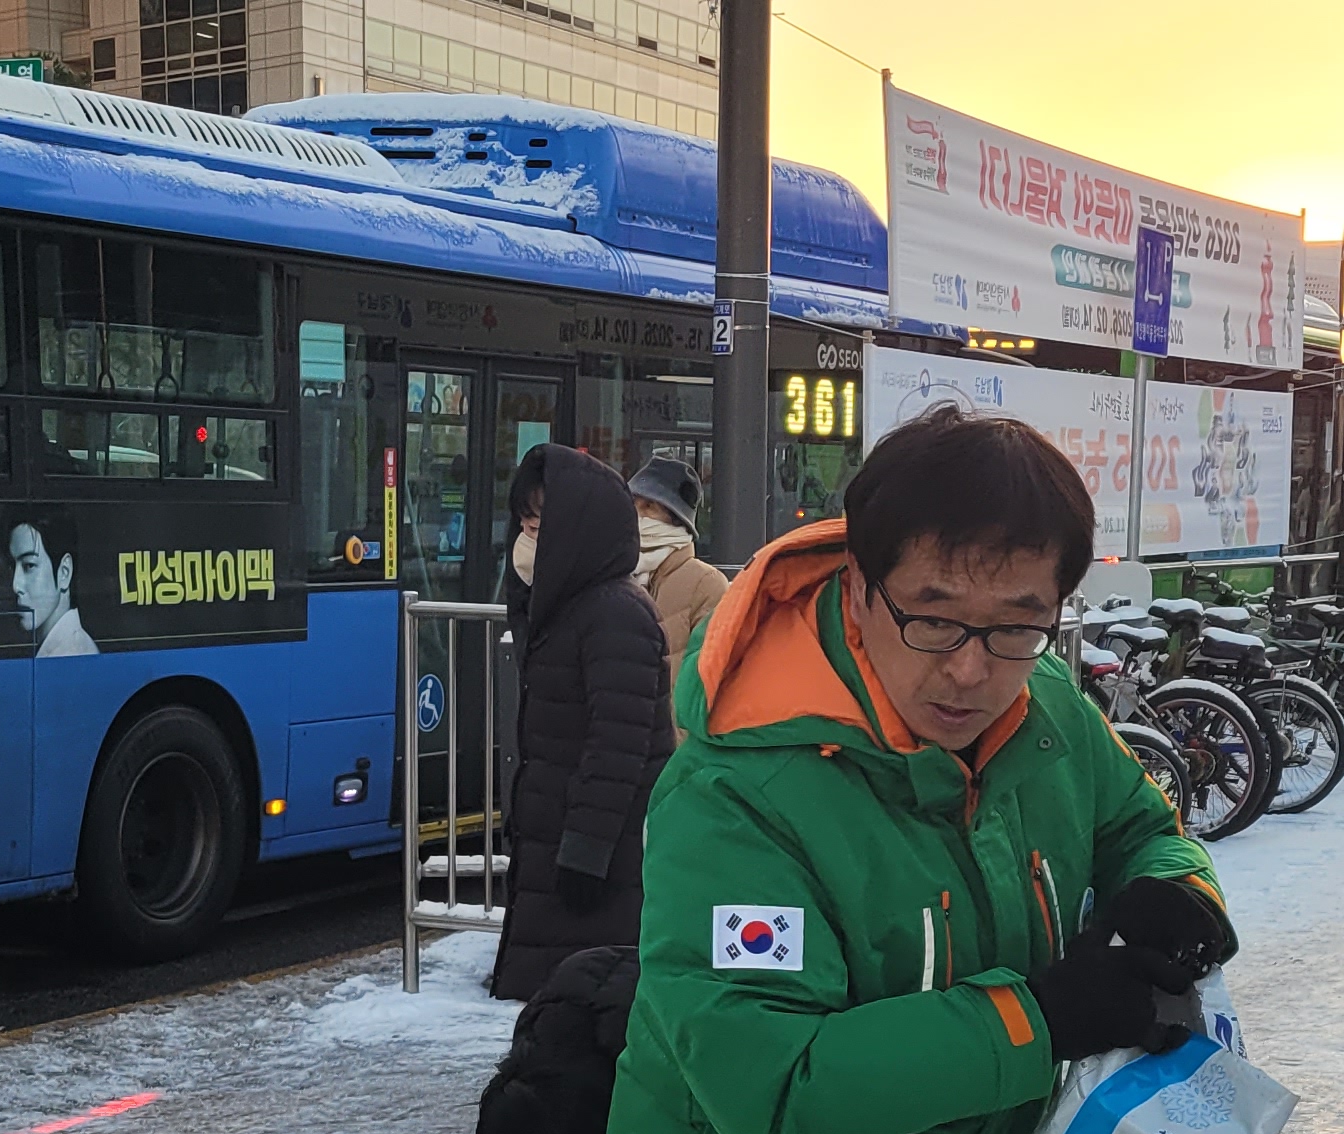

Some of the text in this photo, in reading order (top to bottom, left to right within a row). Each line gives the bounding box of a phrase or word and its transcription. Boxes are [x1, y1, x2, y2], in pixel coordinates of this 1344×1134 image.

[716, 319, 728, 342] 2
[786, 375, 855, 437] 361
[118, 548, 276, 606] 대성마이맥
